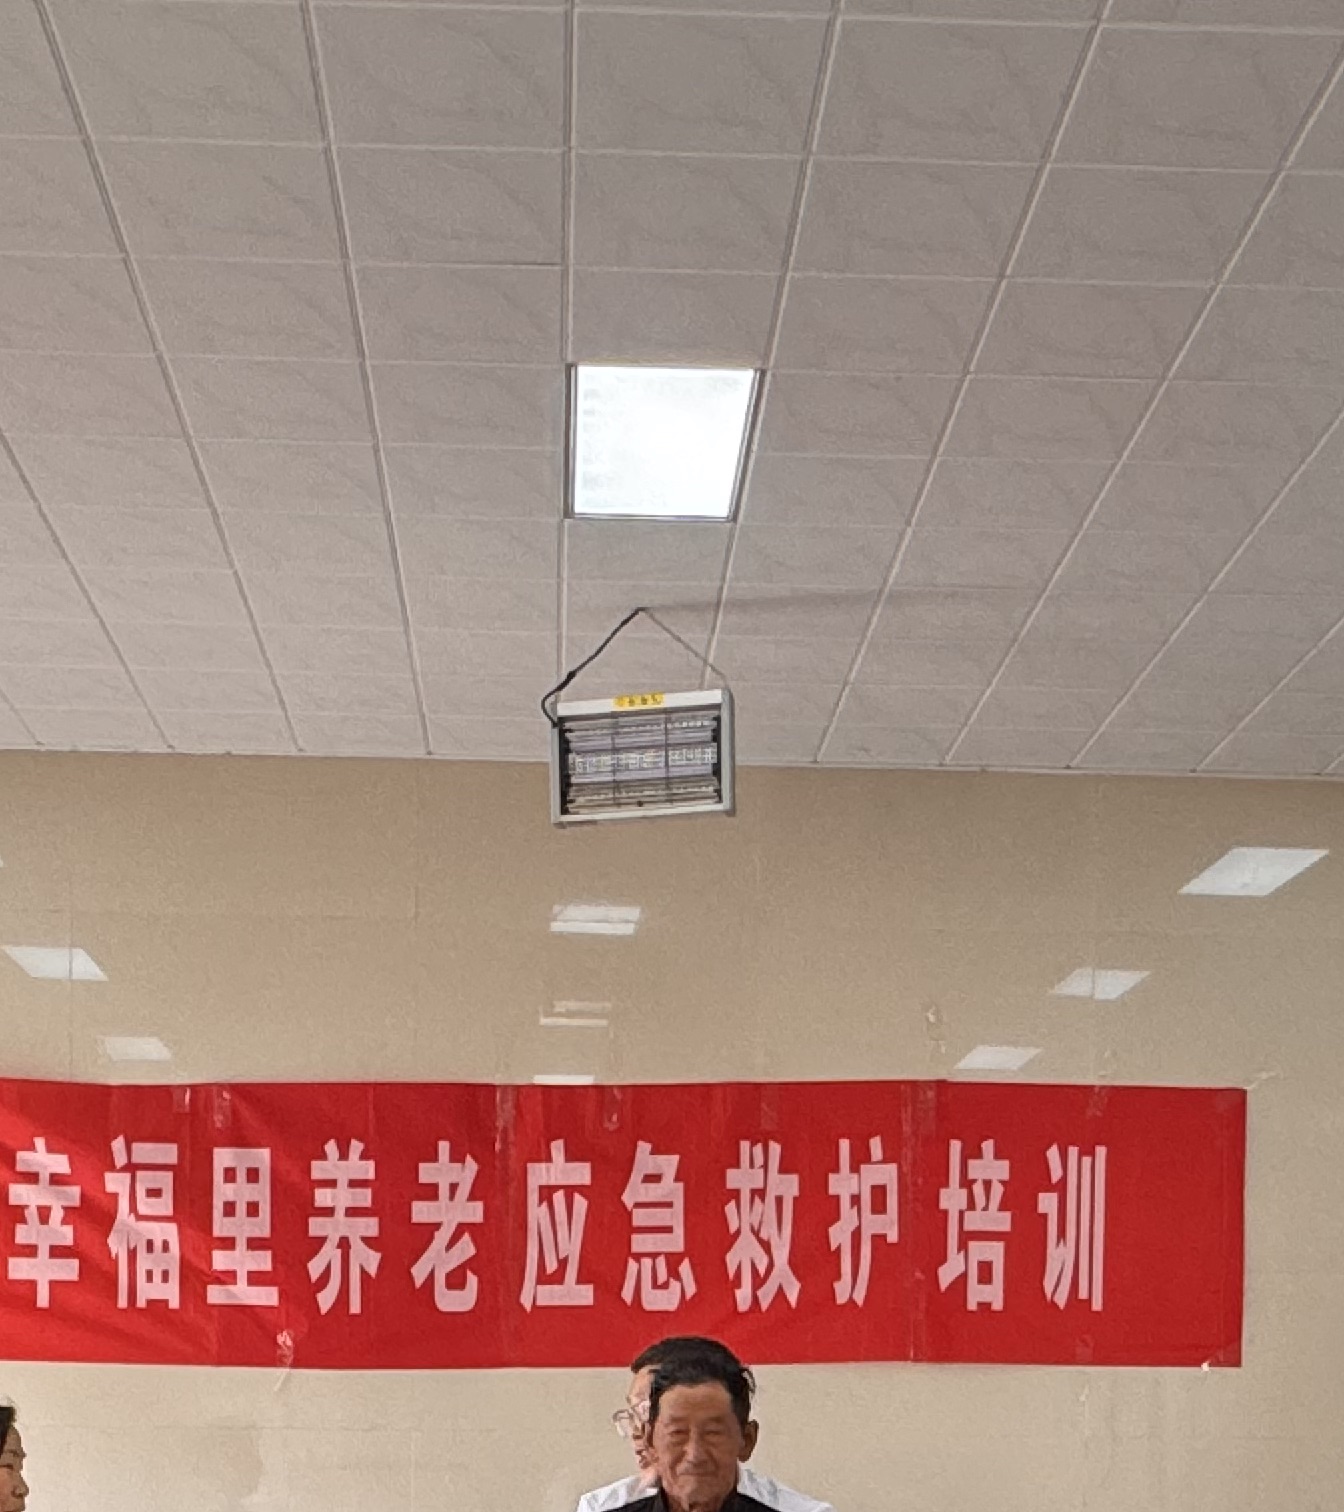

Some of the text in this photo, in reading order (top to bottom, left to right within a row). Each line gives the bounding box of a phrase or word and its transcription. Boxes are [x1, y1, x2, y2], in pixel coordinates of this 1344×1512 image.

[7, 1134, 1108, 1315] 幸福里养老应急救护培训
